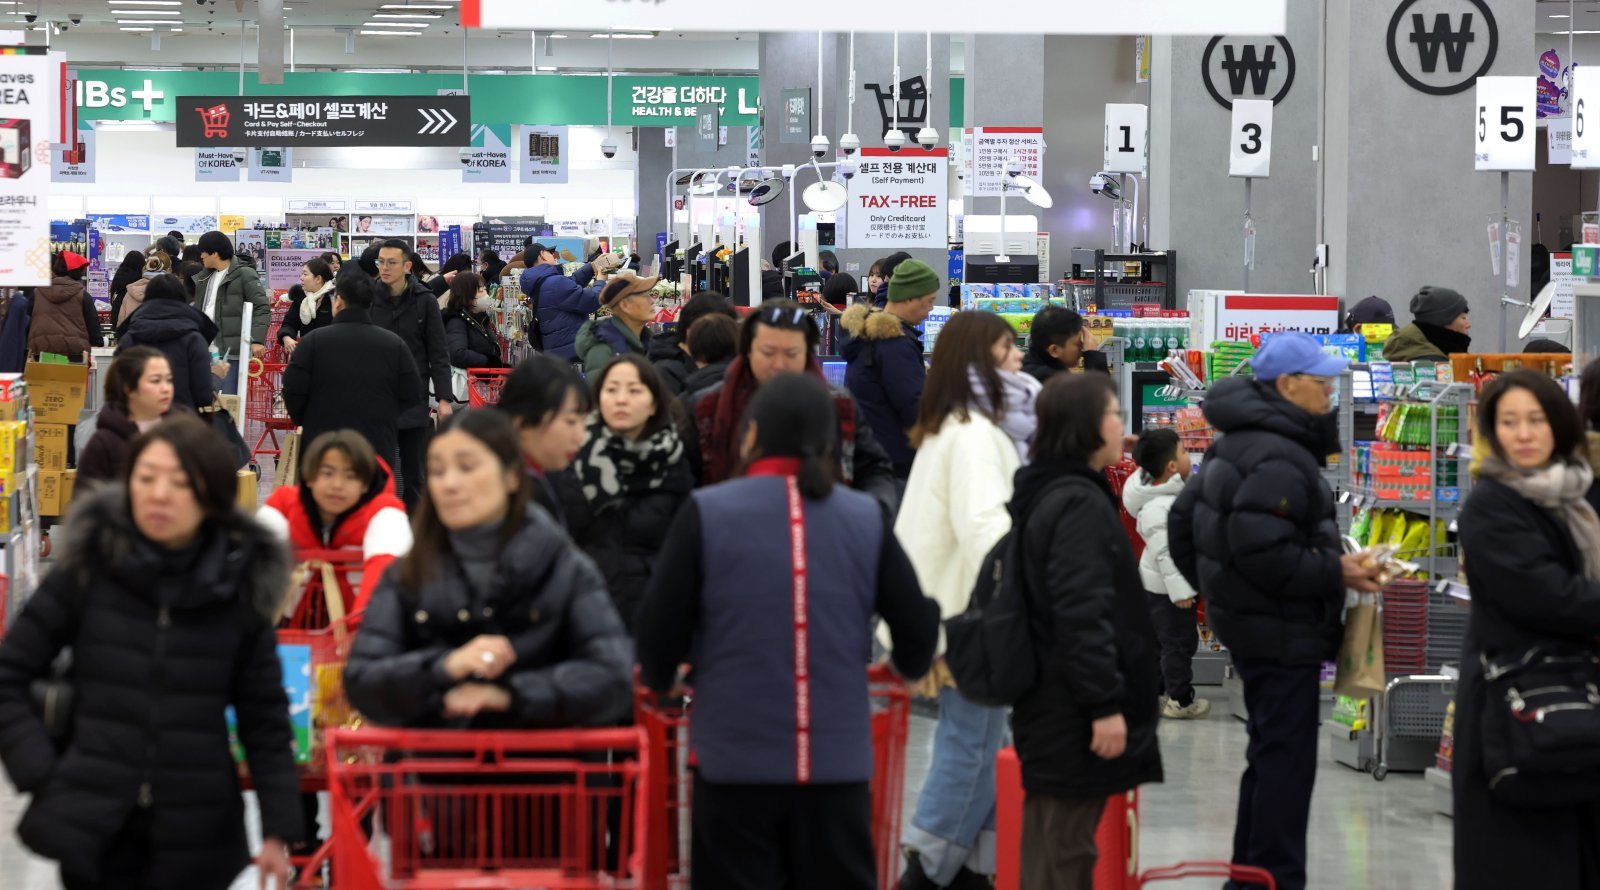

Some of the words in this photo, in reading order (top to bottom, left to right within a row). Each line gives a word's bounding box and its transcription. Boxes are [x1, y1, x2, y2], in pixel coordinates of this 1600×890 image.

[0, 88, 30, 105] EA
[632, 86, 677, 104] 건강을
[680, 86, 727, 104] 더하다
[243, 102, 321, 120] 카드&페이
[323, 102, 389, 120] 셀프계산
[632, 106, 672, 117] HEALTH
[674, 106, 682, 116] &
[684, 106, 726, 117] BEY
[1576, 98, 1585, 138] 6
[244, 120, 260, 128] Card
[261, 120, 267, 128] &
[267, 120, 279, 130] Pay
[280, 120, 328, 128] Self-Checkout
[1479, 106, 1487, 142] 5
[1500, 106, 1524, 142] 5
[299, 129, 365, 138] カード支払いセルフレジ
[1118, 125, 1135, 153] 1
[1240, 122, 1263, 155] 3
[198, 160, 207, 168] Of
[208, 160, 236, 168] KOREA
[477, 160, 507, 168] KOREA
[859, 162, 880, 174] 셀프
[882, 162, 903, 174] 전용
[906, 162, 937, 174] 계산대
[871, 176, 889, 184] (Self
[890, 176, 924, 185] Payment)
[859, 195, 937, 209] TAX-FREE
[870, 215, 886, 223] Only
[1225, 325, 1254, 342] 미리
